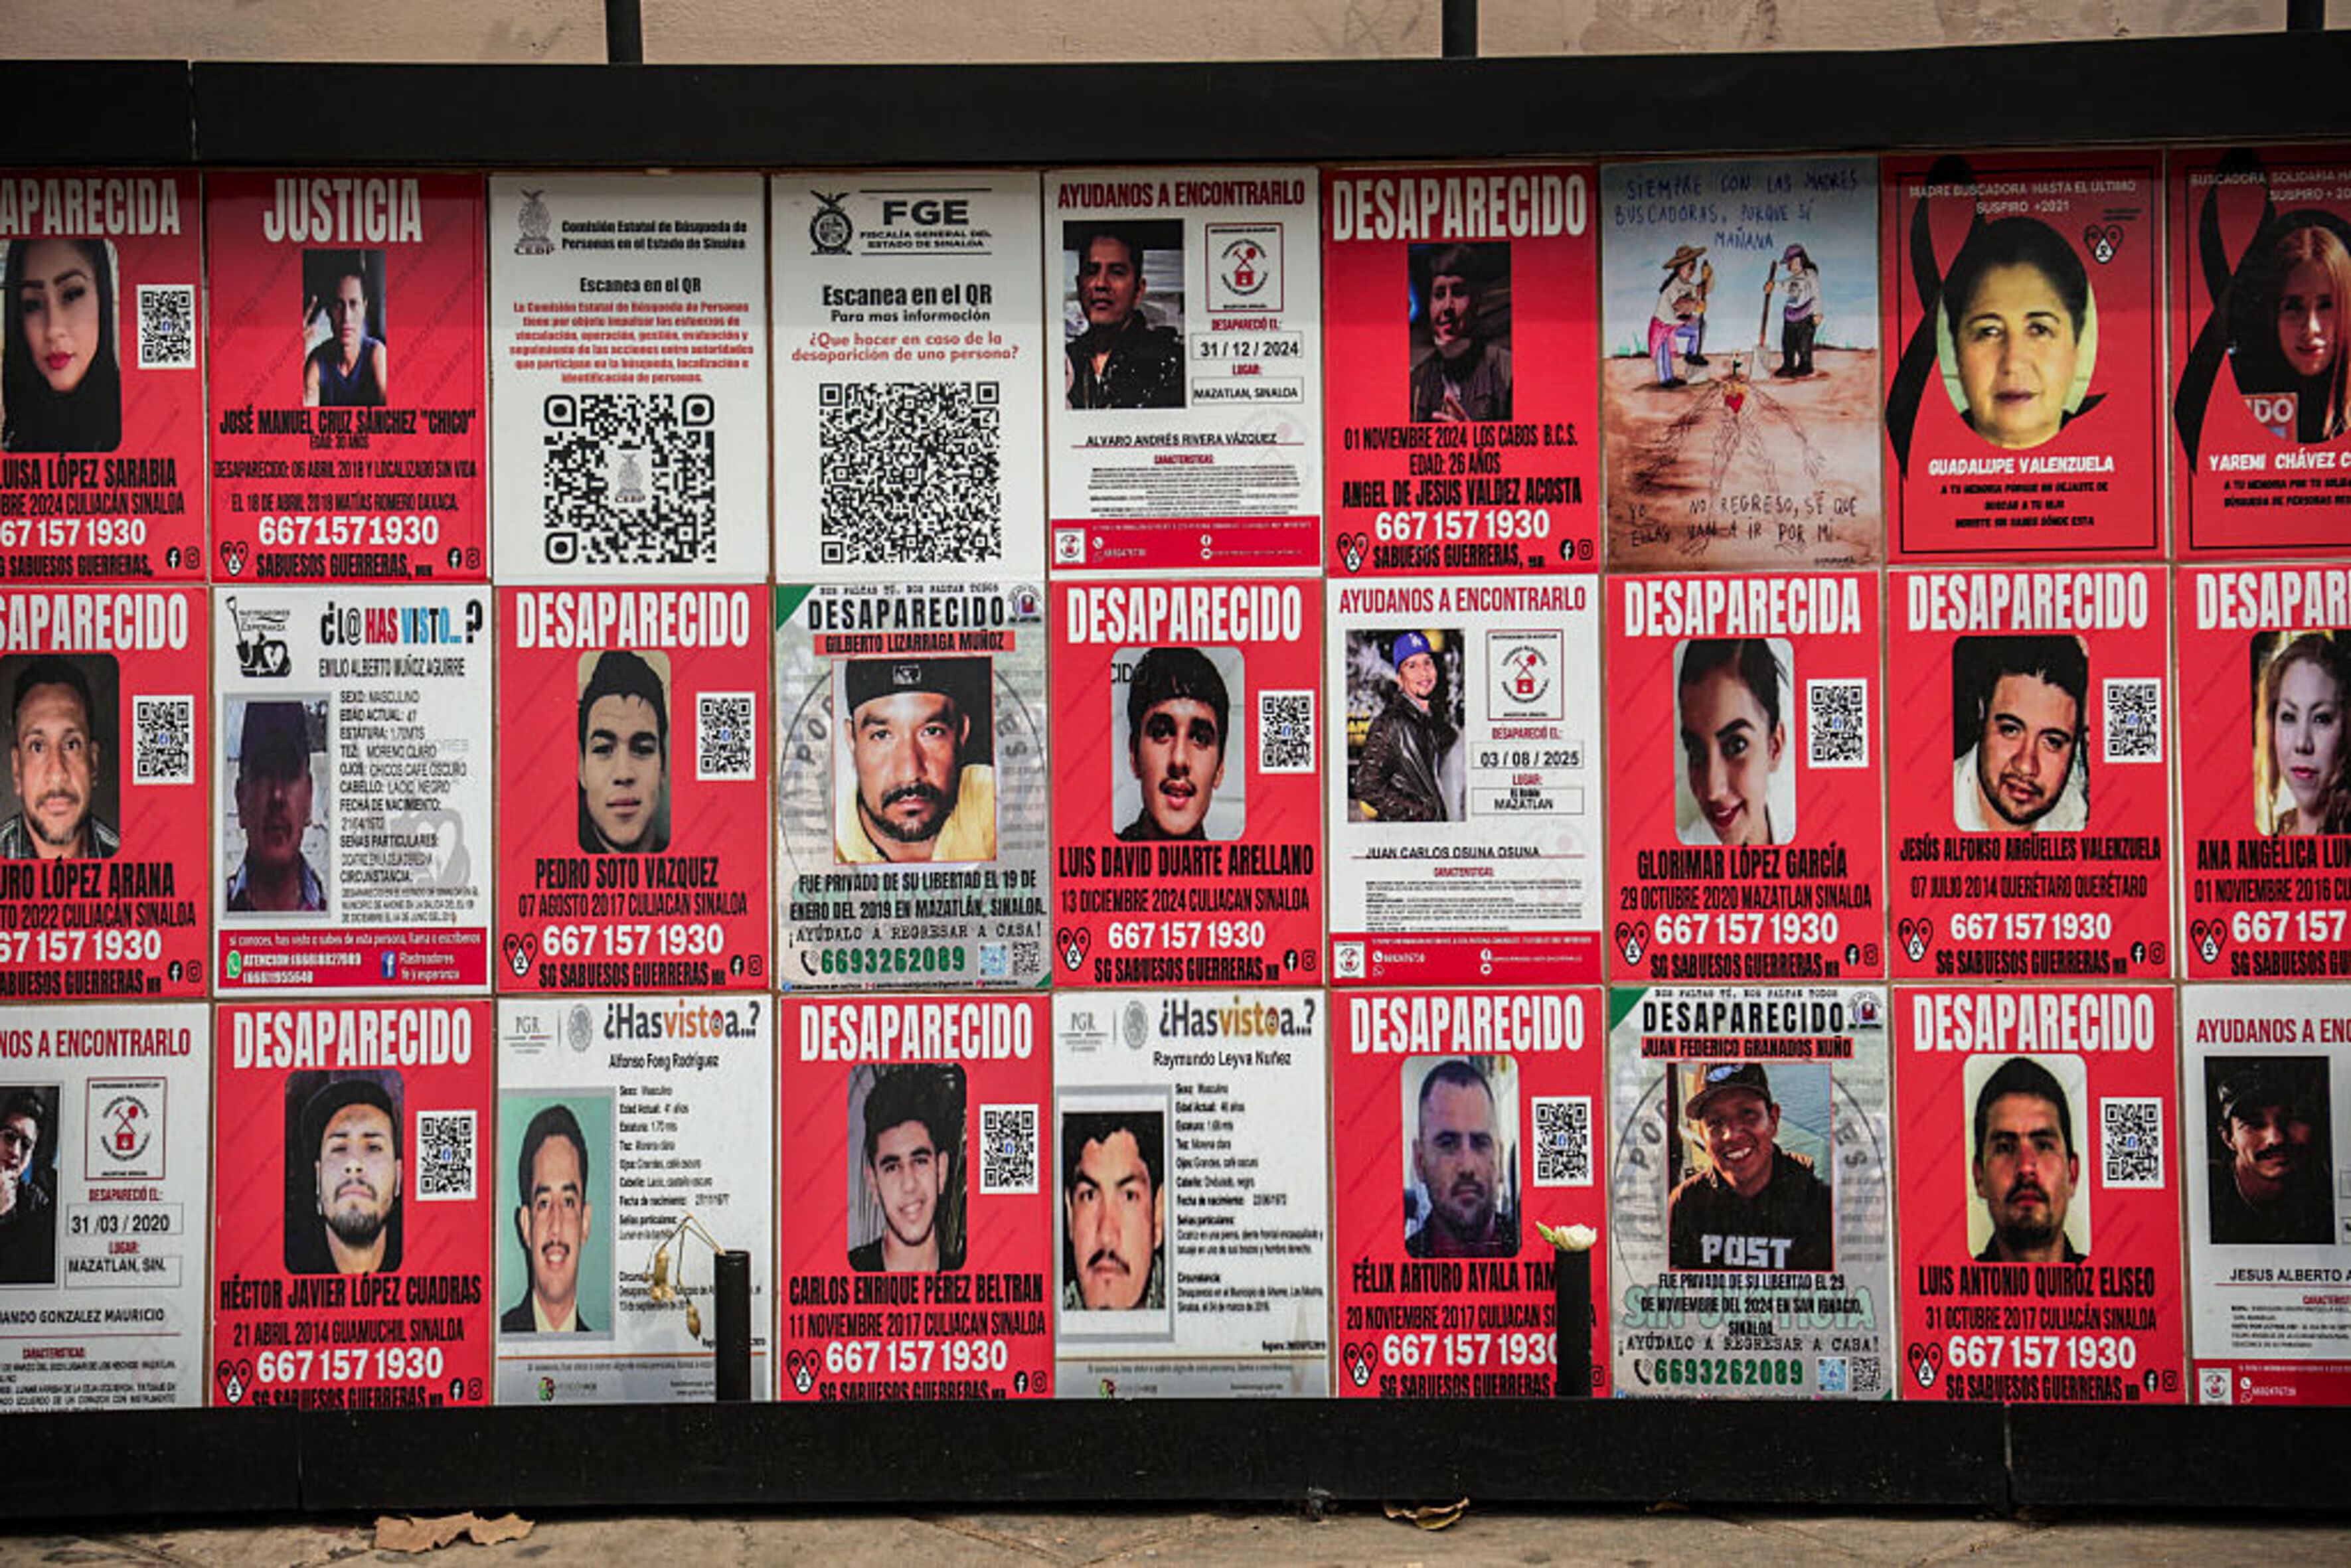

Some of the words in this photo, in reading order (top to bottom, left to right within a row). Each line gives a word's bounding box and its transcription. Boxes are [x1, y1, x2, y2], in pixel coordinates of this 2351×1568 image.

[1058, 183, 1153, 208] AYUDANOS
[1159, 183, 1170, 206] A
[1175, 180, 1304, 206] ENCONTRARLO
[1333, 175, 1587, 240] DESAPARECIDO
[264, 178, 422, 242] JUSTICIA
[884, 200, 968, 225] FGE
[580, 277, 640, 292] Escanea
[644, 279, 661, 292] en
[666, 278, 679, 291] el
[683, 277, 700, 294] QR
[823, 285, 907, 306] Escanea
[912, 287, 936, 305] en
[942, 285, 960, 304] el
[966, 283, 992, 307] QR
[831, 311, 863, 322] Para
[869, 312, 898, 322] mas
[904, 307, 990, 321] información
[854, 333, 898, 345] hacer
[903, 335, 920, 345] en
[926, 335, 959, 345] caso
[965, 332, 983, 345] de
[989, 331, 1002, 345] la
[220, 406, 252, 434] JOSÉ
[258, 410, 313, 434] MANUEL
[319, 410, 351, 434] CRUZ
[357, 405, 416, 434] SÁNCHEZ
[48, 454, 98, 489] LÓPEZ
[105, 459, 177, 487] SARABIA
[1928, 459, 2014, 475] GUADALUPE
[2019, 456, 2114, 473] VALENZUELA
[2275, 447, 2336, 469] CHÁVEZ
[1342, 480, 1388, 508] ANGEL
[1394, 480, 1411, 507] DE
[1416, 479, 1461, 507] JESUS
[1467, 479, 1520, 507] VALDEZ
[1526, 477, 1582, 504] ACOSTA
[259, 516, 438, 545] 6671571930
[257, 554, 325, 578] SABUESOS
[809, 597, 1005, 630] DESAPARECIDO
[1067, 585, 1301, 643] DESAPARECIDO
[1340, 588, 1433, 613] AYUDANOS
[1439, 588, 1451, 612] A
[1457, 587, 1586, 611] ENCONTRARLO
[1625, 578, 1860, 637] DESAPARECIDA
[1907, 572, 2148, 631] DESAPARECIDO
[366, 607, 396, 644] HAS
[516, 591, 749, 648] DESAPARECIDO
[826, 634, 883, 653] GILBERTO
[888, 633, 955, 652] LIZARRAGA
[959, 629, 1004, 651] MUÑOZ
[1495, 799, 1553, 810] MAZATLAN
[1059, 846, 1095, 878] LUIS
[1101, 846, 1152, 878] DAVID
[1159, 846, 1222, 876] DUARTE
[1228, 844, 1314, 875] ARELLANO
[1366, 848, 1396, 859] JUAN
[1401, 847, 1449, 859] CARLOS
[1637, 848, 1724, 880] GLORIMAR
[1730, 843, 1780, 879] LÓPEZ
[1786, 842, 1847, 878] GARCÍA
[1900, 834, 1939, 862] JESÚS
[1945, 838, 2000, 862] ALFONSO
[2006, 834, 2075, 861] ARGÜELLES
[2081, 837, 2160, 861] VALENZUELA
[2198, 840, 2229, 870] ANA
[2237, 835, 2318, 869] ANGÉLICA
[42, 854, 101, 899] LÓPEZ
[109, 862, 175, 898] ARANA
[535, 858, 590, 890] PEDRO
[595, 858, 639, 888] SOTO
[645, 857, 718, 888] VAZQUEZ
[22, 904, 57, 929] 2022
[62, 898, 131, 928] CULIACÁN
[135, 902, 196, 927] SINALOA
[519, 895, 535, 917] 07
[539, 894, 588, 917] AGOSTO
[592, 894, 625, 917] 2017
[628, 893, 691, 917] CULIACAN
[695, 892, 747, 915] SINALOA
[821, 946, 965, 974] 6693262089
[801, 1003, 1032, 1061] DESAPARECIDO
[1350, 994, 1584, 1054] DESAPARECIDO
[1643, 1002, 1843, 1033] DESAPARECIDO
[1914, 993, 2154, 1052] DESAPARECIDO
[2197, 1020, 2297, 1044] AYUDANOS
[2303, 1020, 2315, 1044] A
[38, 1030, 50, 1057] A
[56, 1028, 190, 1058] ENCONTRARLO
[234, 1008, 471, 1068] DESAPARECIDO
[1642, 1039, 1675, 1057] JUAN
[1680, 1039, 1740, 1057] FEDERICO
[1744, 1039, 1811, 1057] GRANADOS
[1816, 1035, 1851, 1057] NUÑO
[1701, 1234, 1792, 1269] POST
[789, 1275, 849, 1306] CARLOS
[854, 1275, 918, 1306] ENRIQUE
[925, 1271, 972, 1305] PÉREZ
[977, 1274, 1042, 1303] BELTRAN
[1353, 1256, 1395, 1293] FÉLIX
[1400, 1263, 1463, 1293] ARTURO
[1469, 1263, 1519, 1292] AYALA
[1919, 1268, 1954, 1297] LUIS
[1960, 1267, 2030, 1296] ANTONIO
[2100, 1267, 2154, 1297] ELISEO
[2229, 1269, 2273, 1281] JESUS
[2277, 1269, 2342, 1281] ALBERTO
[220, 1274, 283, 1310] HÉCTOR
[288, 1277, 345, 1307] JAVIER
[351, 1272, 400, 1306] LÓPEZ
[406, 1275, 481, 1304] CUADRAS
[39, 1310, 101, 1323] GONZALEZ
[105, 1308, 164, 1322] MAURICIO
[1655, 1358, 1803, 1385] 6693262089
